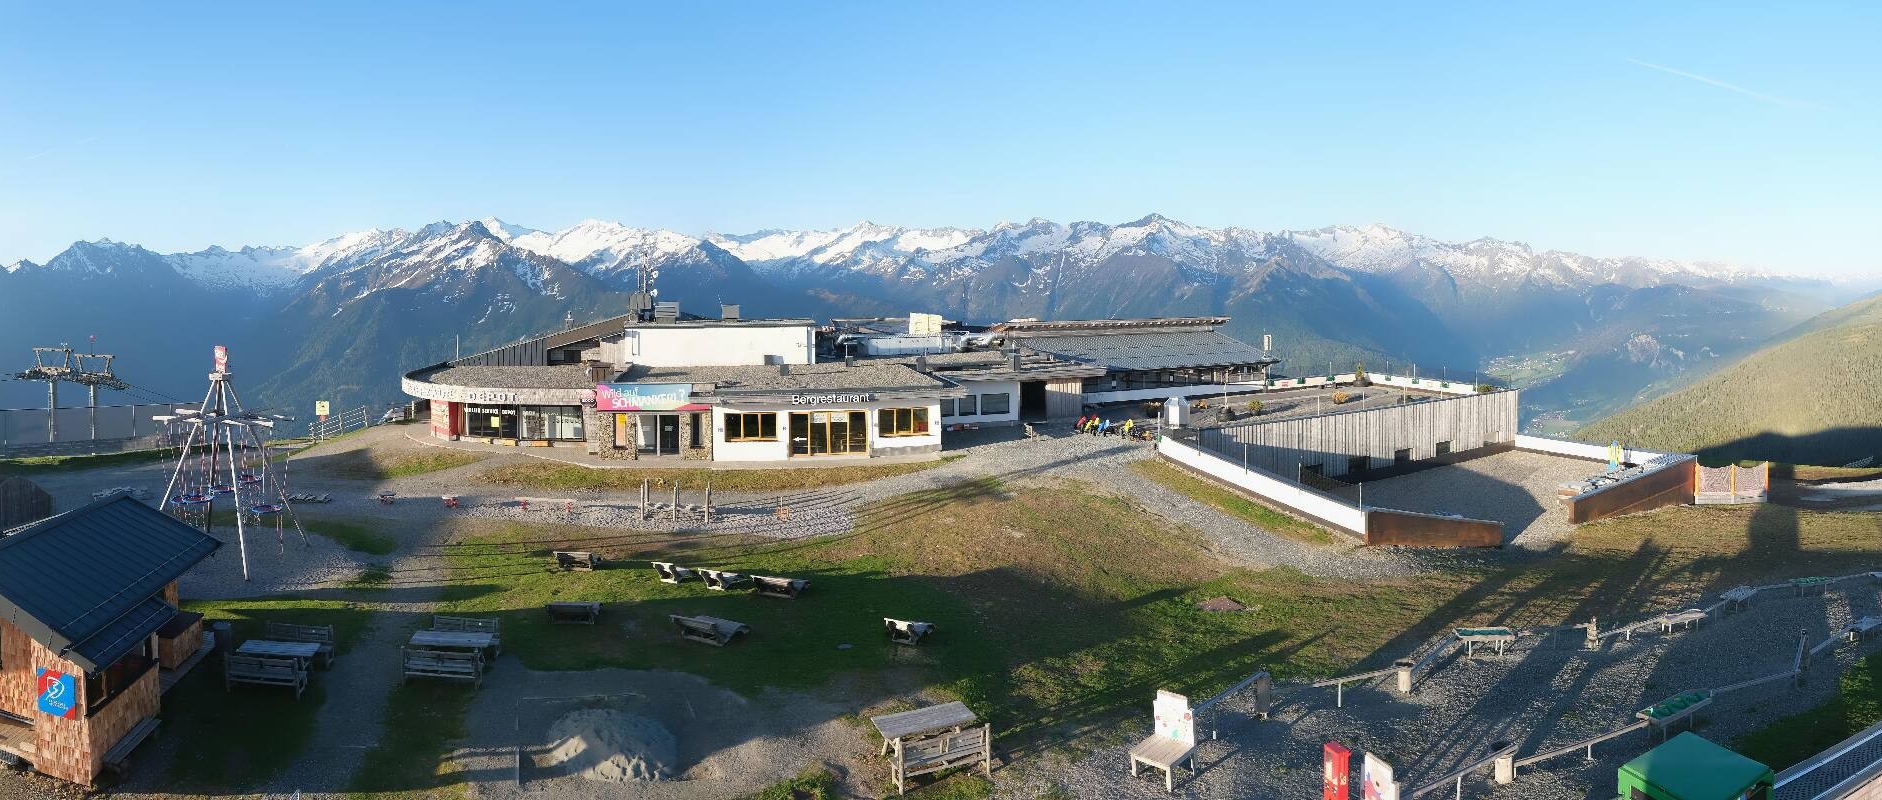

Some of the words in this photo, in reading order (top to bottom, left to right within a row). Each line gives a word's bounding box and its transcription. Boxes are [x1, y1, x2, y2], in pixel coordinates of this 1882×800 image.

[602, 388, 622, 399] Wild
[623, 387, 639, 396] auf
[792, 393, 870, 406] Bergrestaurant
